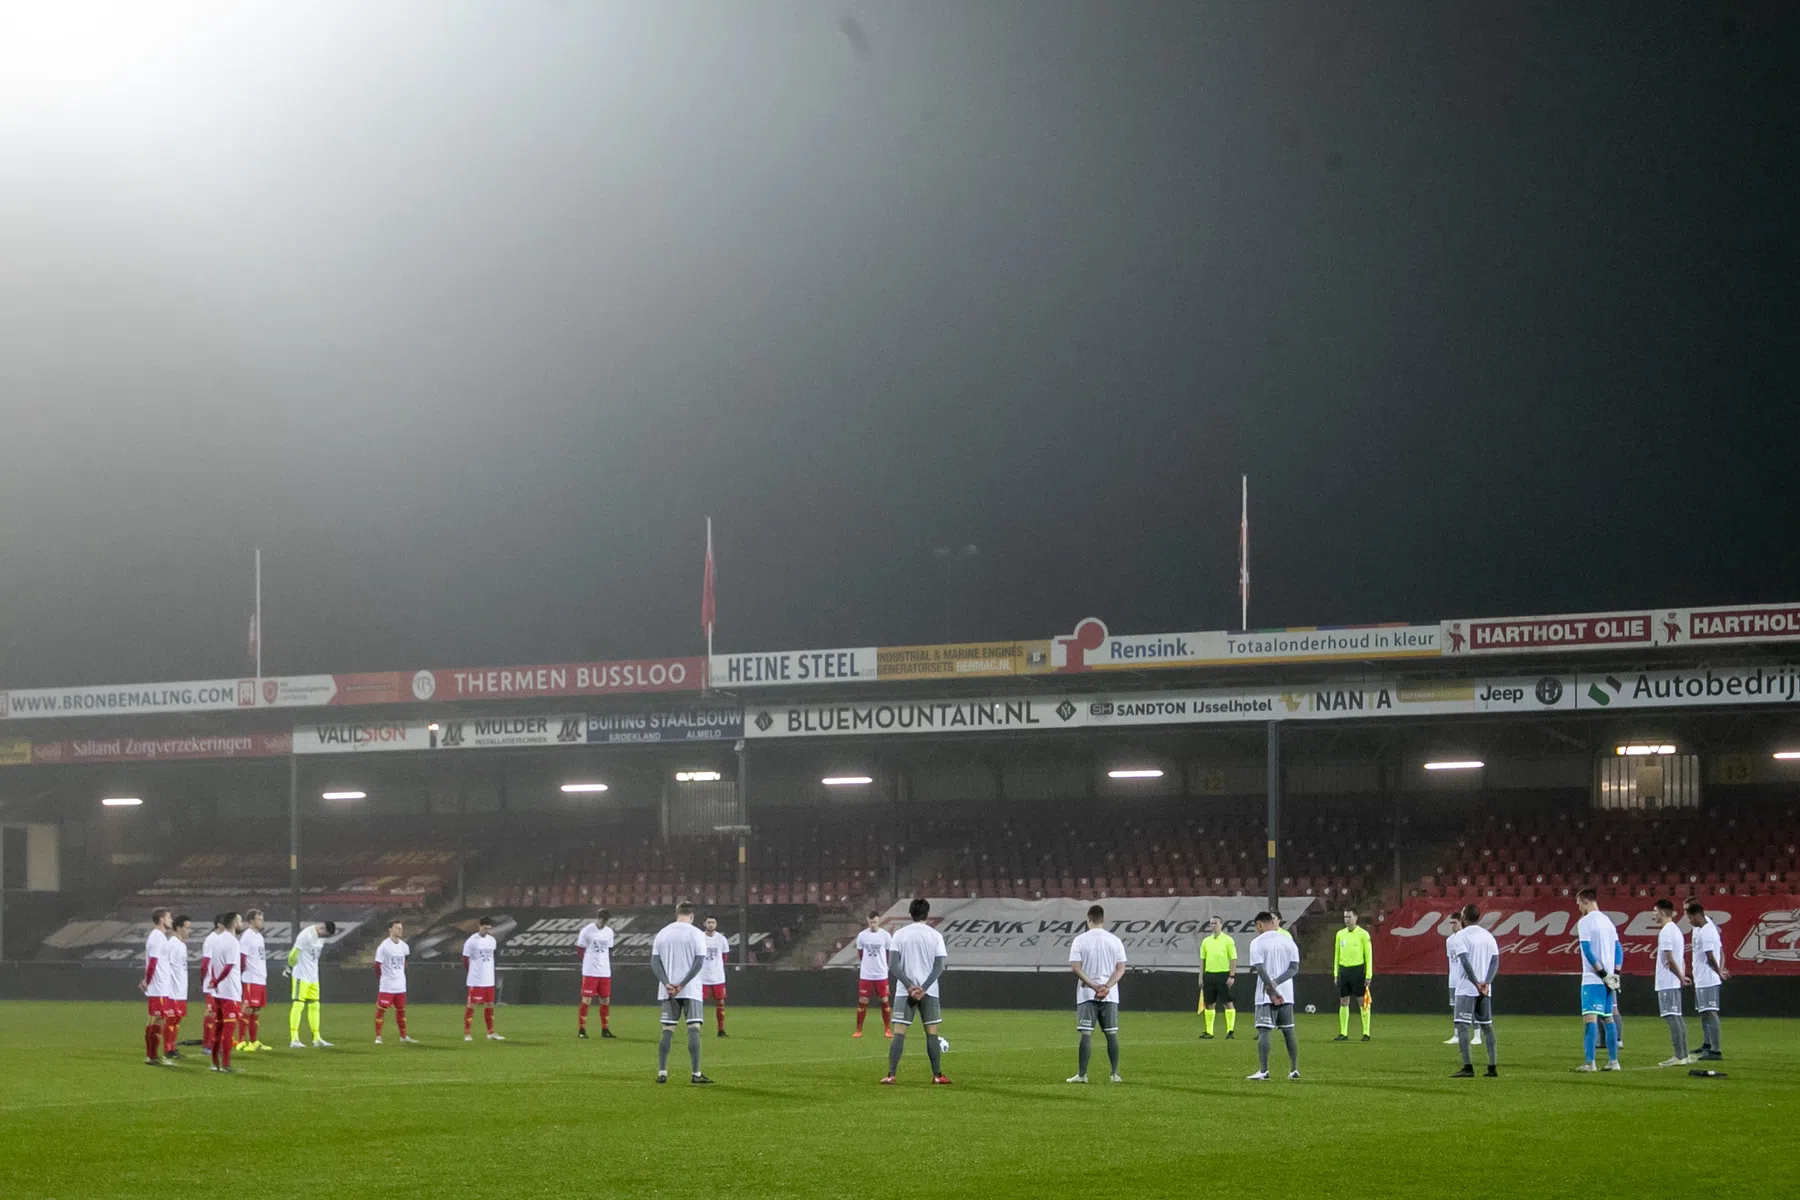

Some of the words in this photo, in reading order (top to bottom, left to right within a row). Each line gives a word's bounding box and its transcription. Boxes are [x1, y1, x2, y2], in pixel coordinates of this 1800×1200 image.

[1476, 622, 1587, 644] HARTHOLT
[1594, 619, 1644, 638] OLIE
[1694, 613, 1800, 634] HARTHOL
[877, 651, 931, 663] INDUSTRIAL
[933, 651, 941, 661] &
[943, 648, 980, 661] MARINE
[982, 645, 1023, 658] ENGINES
[1110, 637, 1195, 659] Rensink.
[1227, 634, 1370, 655] Totaalonderhoud
[1375, 633, 1389, 648] in
[1393, 632, 1435, 647] kleur
[728, 654, 791, 682] HEINE
[798, 652, 860, 680] STEEL
[877, 661, 954, 675] GENERATORSETS
[453, 668, 568, 693] THERMEN
[576, 663, 687, 688] BUSSLOO
[1633, 667, 1800, 701] Autobedrij
[12, 687, 233, 712] WWW.BRONBEMALING.COM
[1480, 685, 1524, 703] Jeep
[788, 701, 1040, 733] BLUEMOUNTAIN.NL
[1117, 702, 1186, 717] SANDTON
[1193, 697, 1272, 715] IJsselhotel
[474, 717, 548, 736] MULDER
[589, 715, 646, 731] BUITING
[650, 709, 742, 728] STAALBOUW
[686, 729, 721, 739] ALMELO
[943, 919, 1034, 934] HENK
[1109, 919, 1287, 934] TONGERE
[1053, 934, 1185, 949] Teniek
